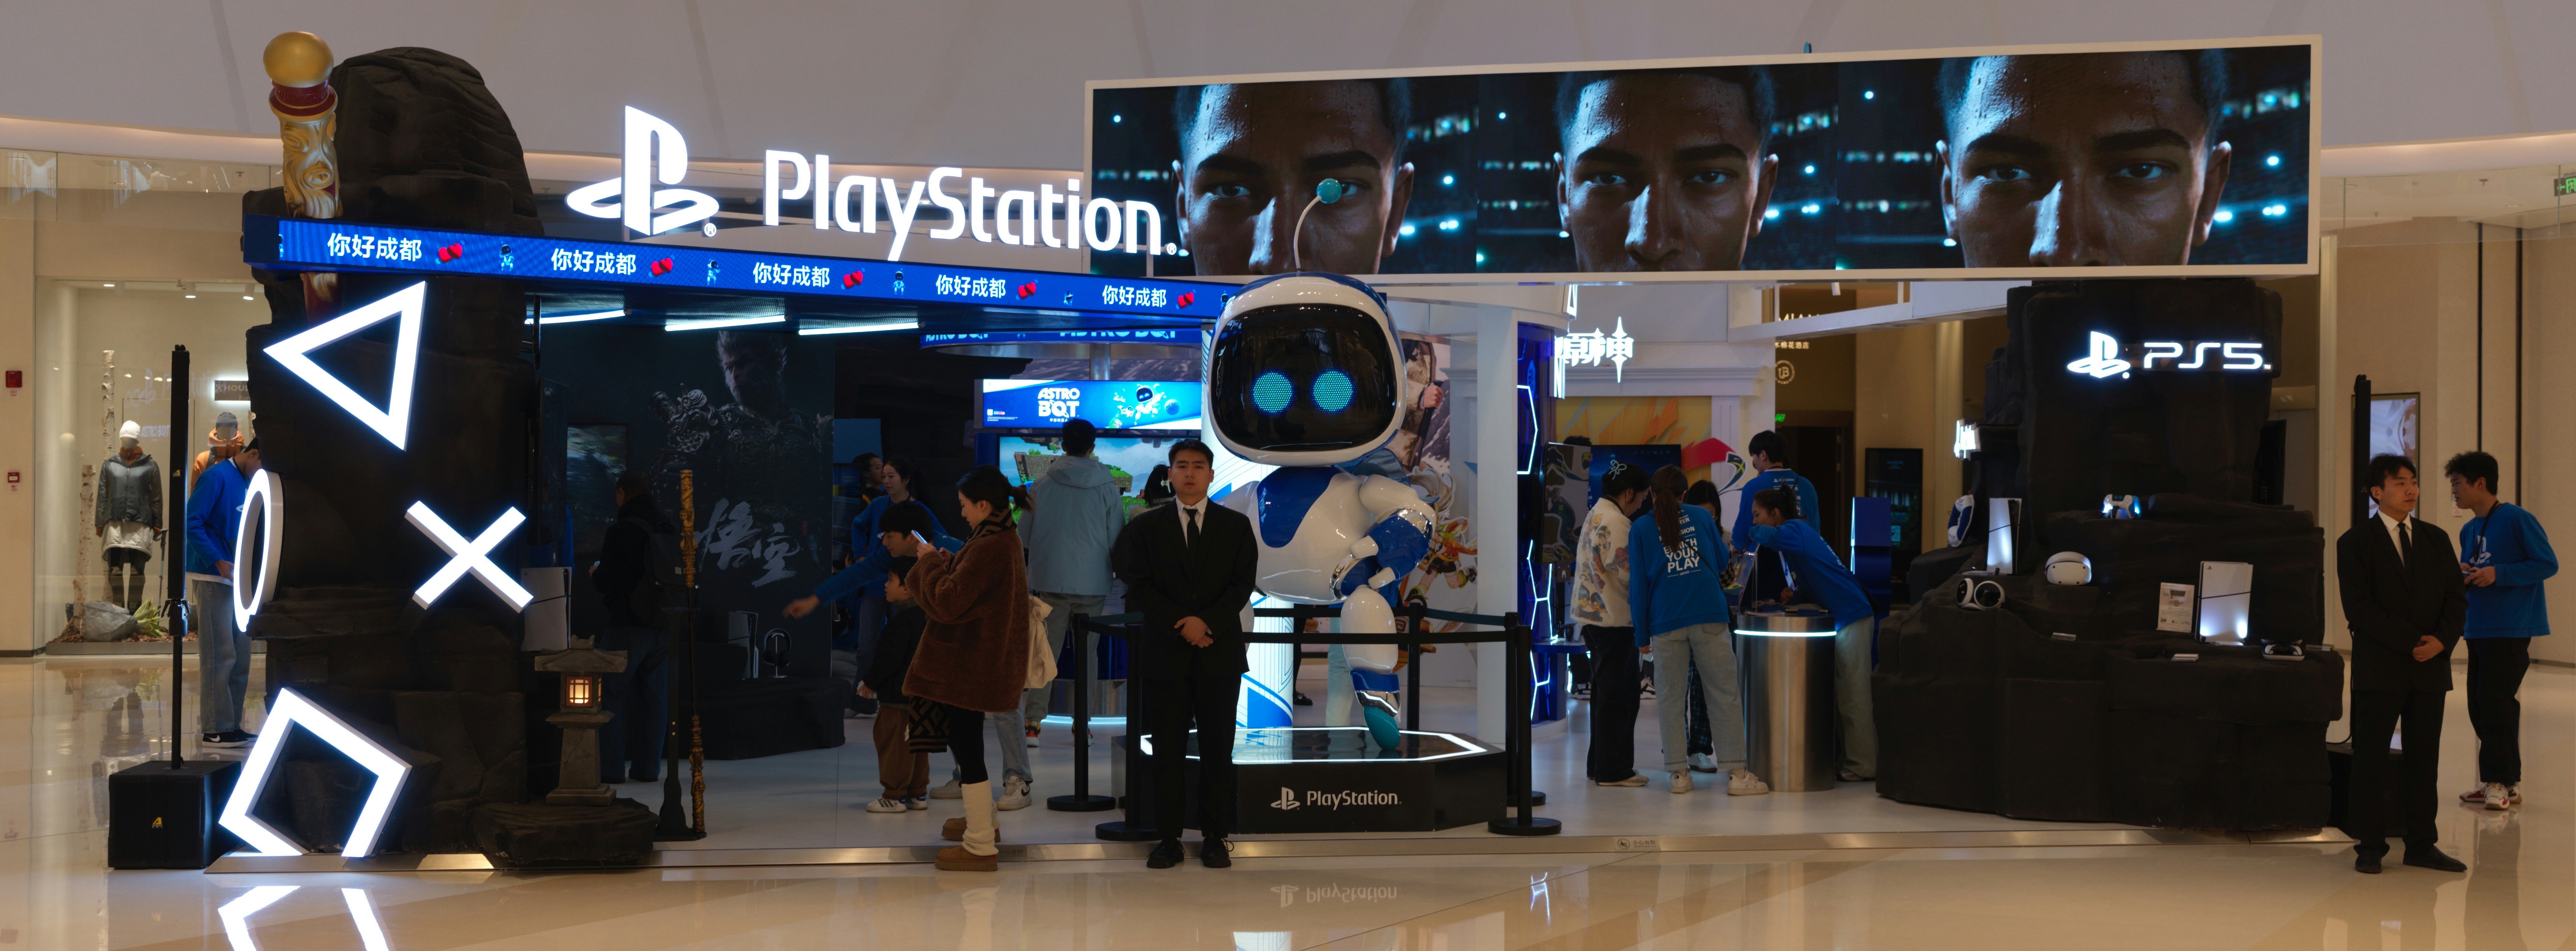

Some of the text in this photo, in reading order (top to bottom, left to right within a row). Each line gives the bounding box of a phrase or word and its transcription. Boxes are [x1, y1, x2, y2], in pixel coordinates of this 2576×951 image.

[765, 149, 1162, 261] PlayStation
[327, 233, 422, 262] 你好成都
[551, 248, 637, 275] 你好成都
[752, 262, 830, 288] 你好成都
[935, 274, 1006, 299] 你好成都
[1102, 285, 1167, 308] 你好成都
[2144, 342, 2263, 370] PS5
[1038, 388, 1080, 400] ASTRO
[1038, 399, 1080, 418] BOT
[1667, 556, 1700, 573] PLAY
[1307, 790, 1398, 810] PlayStation
